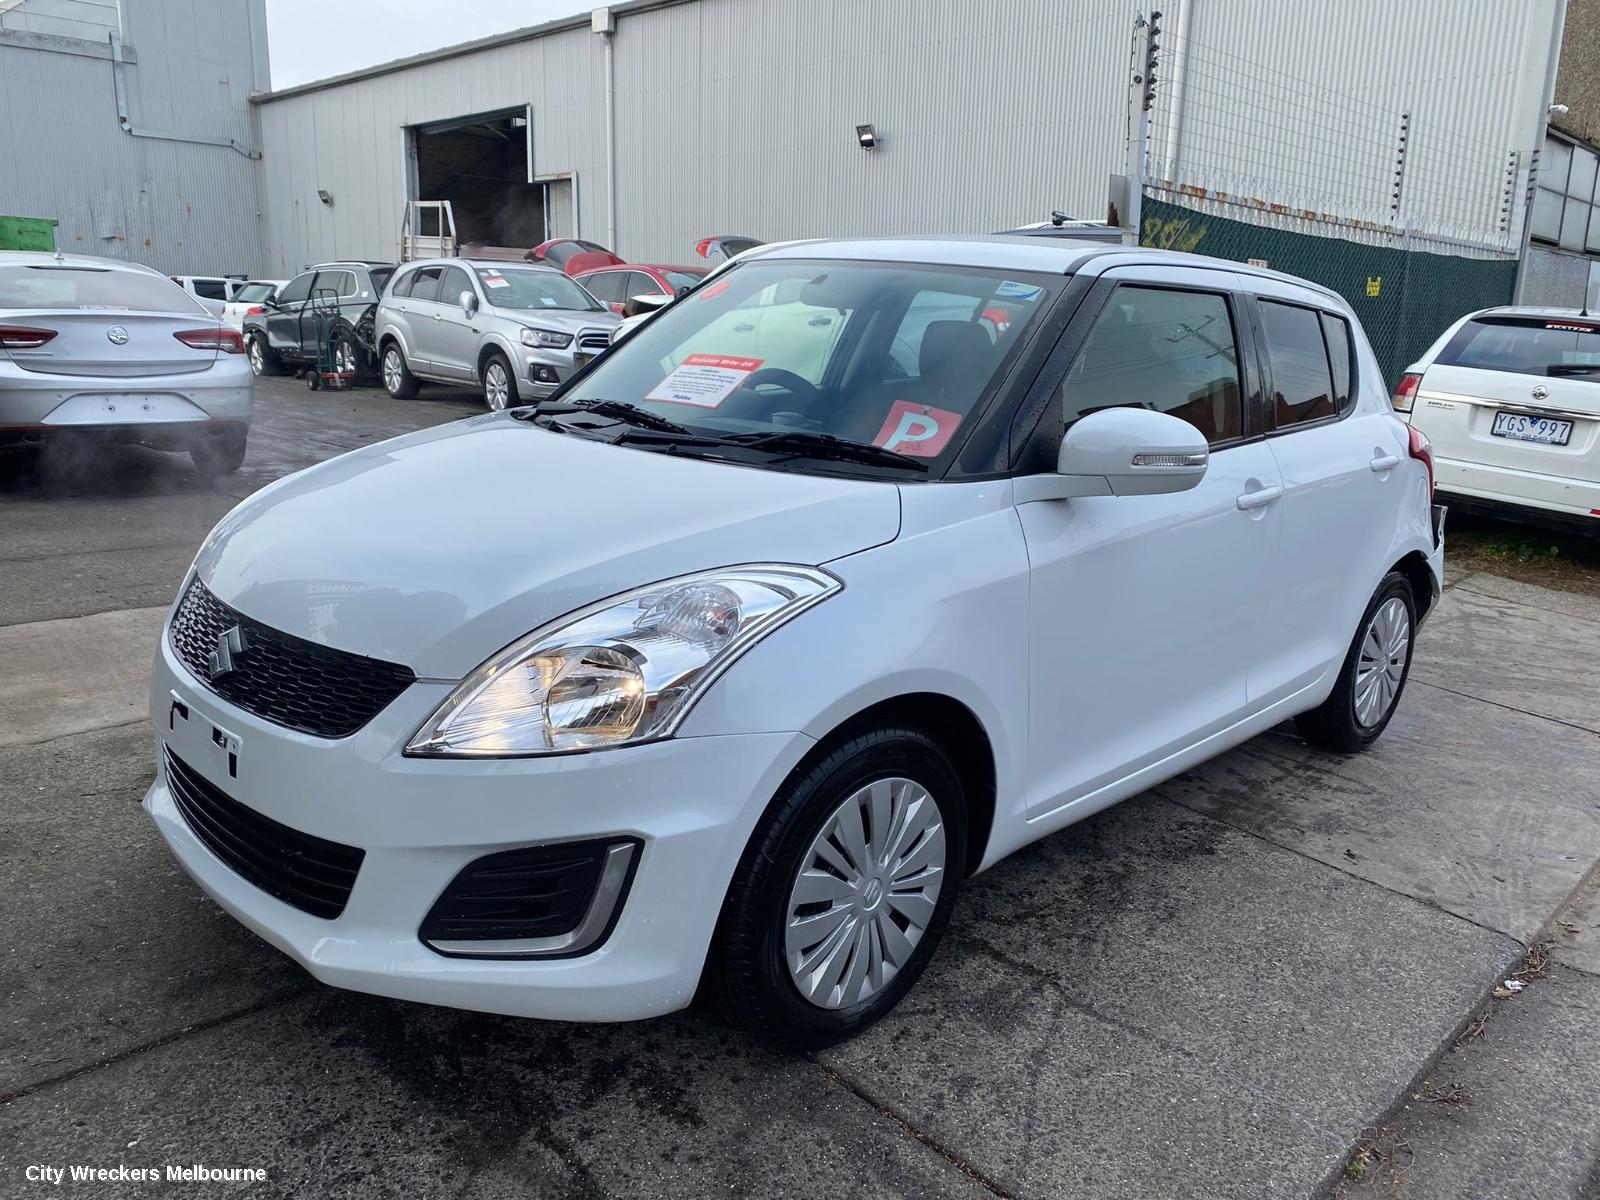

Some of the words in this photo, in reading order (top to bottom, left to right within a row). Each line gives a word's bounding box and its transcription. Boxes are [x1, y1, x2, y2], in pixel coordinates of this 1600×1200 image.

[883, 411, 939, 450] P
[1498, 415, 1527, 432] YGS
[1538, 421, 1569, 438] 997
